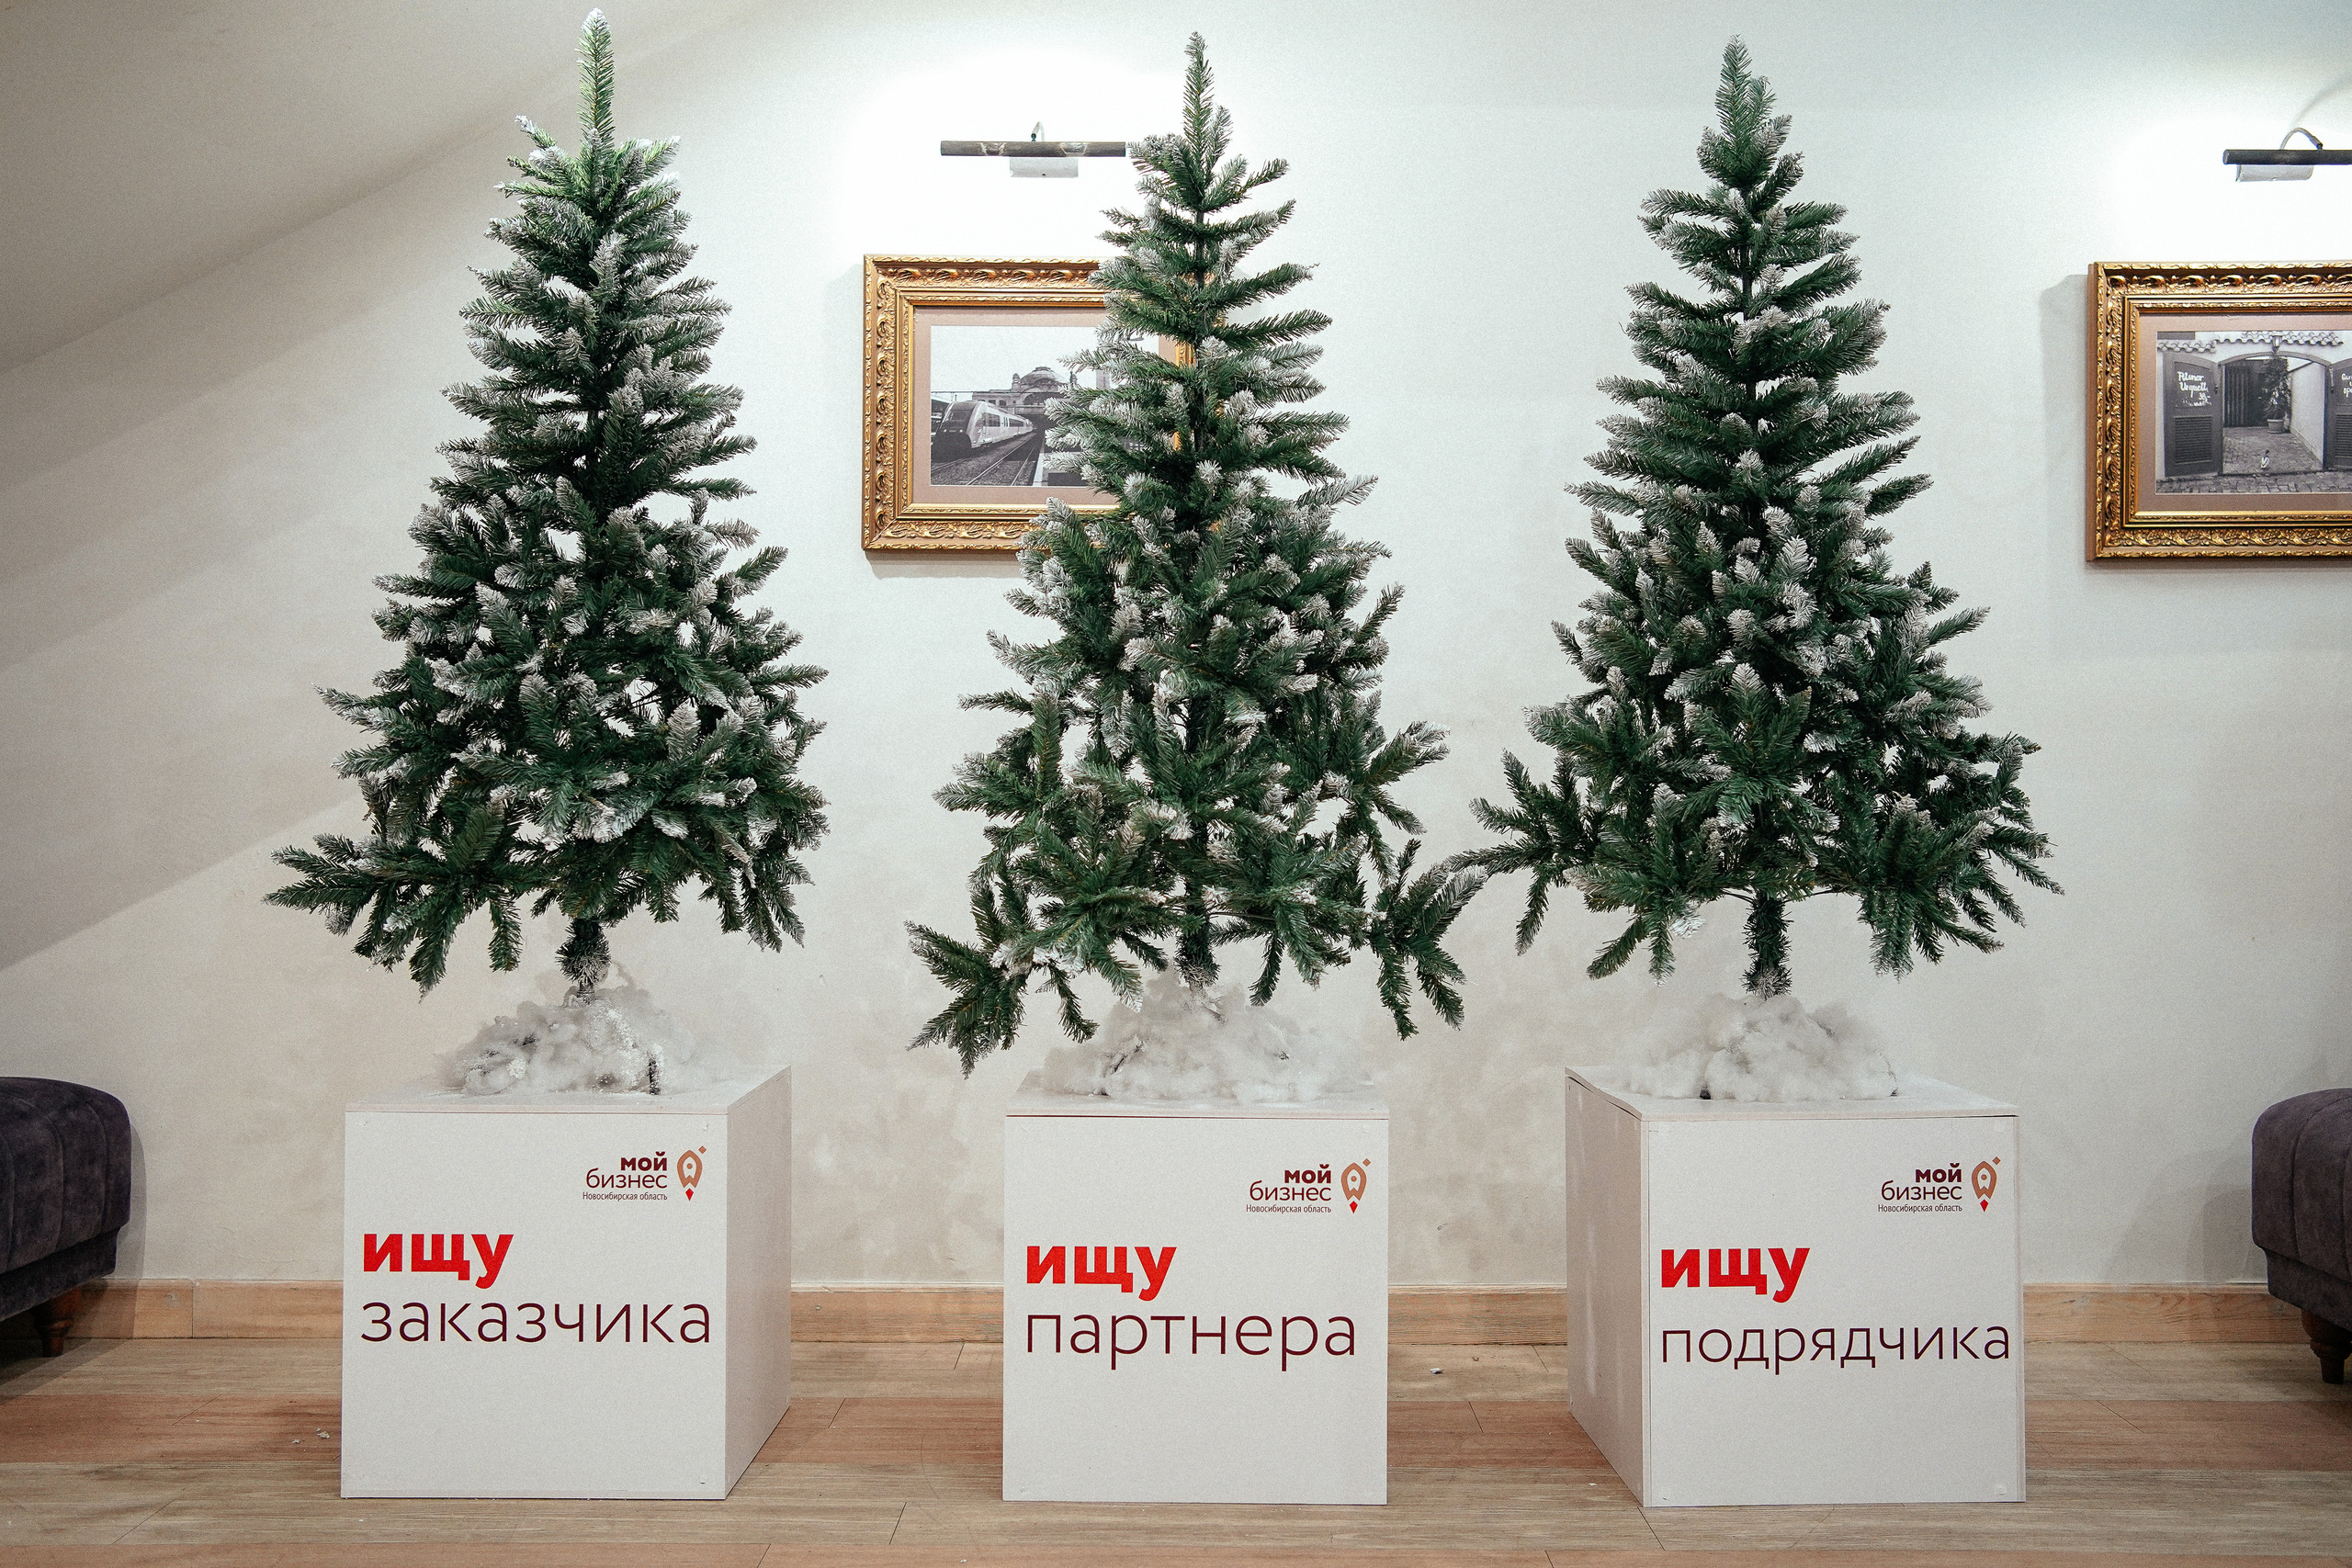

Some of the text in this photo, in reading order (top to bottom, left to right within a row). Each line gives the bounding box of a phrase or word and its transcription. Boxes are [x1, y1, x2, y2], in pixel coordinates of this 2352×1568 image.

[621, 1151, 668, 1171] мой
[586, 1168, 668, 1189] бизнес
[1284, 1164, 1331, 1184] мой
[1916, 1163, 1962, 1183] мой
[582, 1191, 668, 1201] Новосибирская область
[1250, 1179, 1332, 1201] бизнес
[1881, 1179, 1962, 1201] бизнес
[1246, 1204, 1332, 1214] Новосибирская область
[1877, 1203, 1962, 1213] Новосибирская область
[363, 1234, 514, 1289] ищу
[1026, 1246, 1177, 1302] ищу
[1660, 1247, 1811, 1303] ищу
[361, 1302, 710, 1343] заказчика
[1027, 1314, 1355, 1371] партнера
[1662, 1325, 2010, 1375] подрядчика
